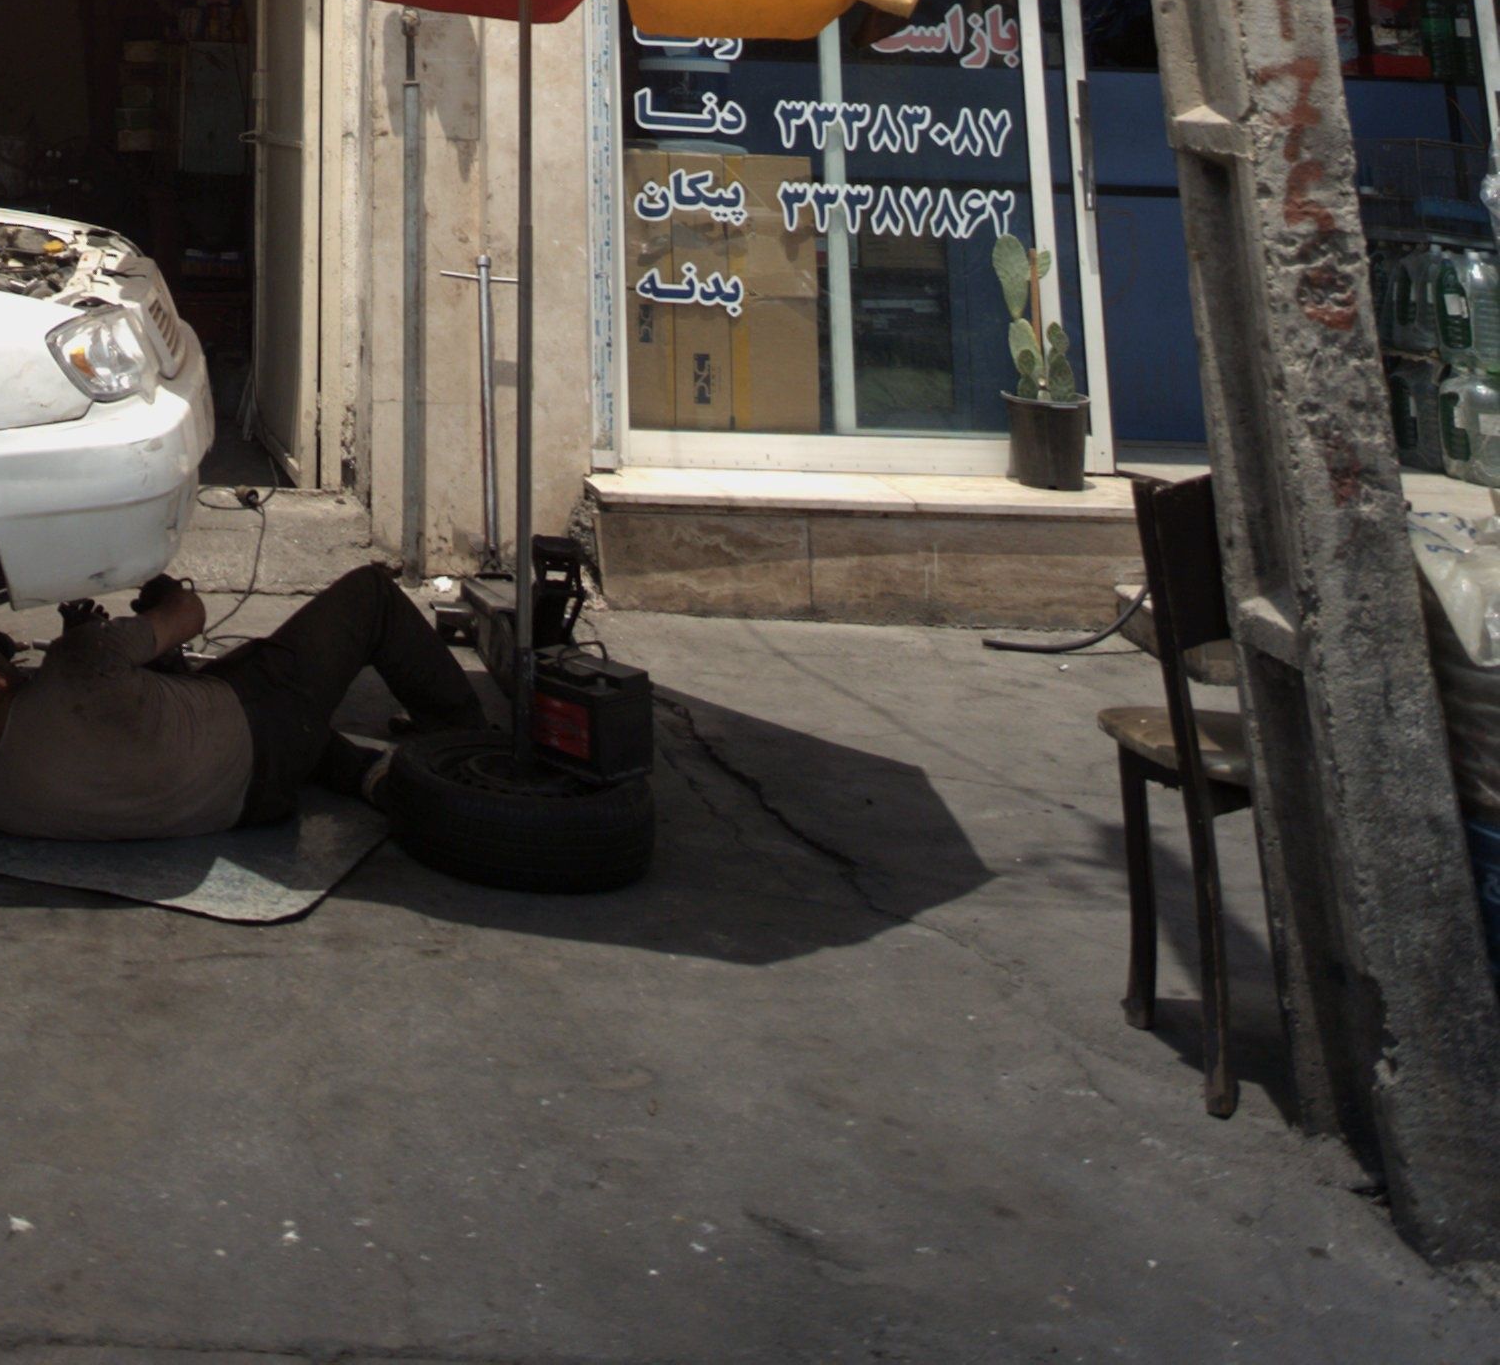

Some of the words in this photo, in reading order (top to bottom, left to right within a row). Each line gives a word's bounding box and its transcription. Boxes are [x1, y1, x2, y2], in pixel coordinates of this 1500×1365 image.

[634, 87, 747, 135] دنا
[773, 99, 1012, 157] ۳۳۳۸۳۰۸۷
[635, 169, 747, 226] پیکان
[776, 181, 1015, 239] ۳۳۳۸۷۸۶۲
[635, 261, 744, 318] بدنه
